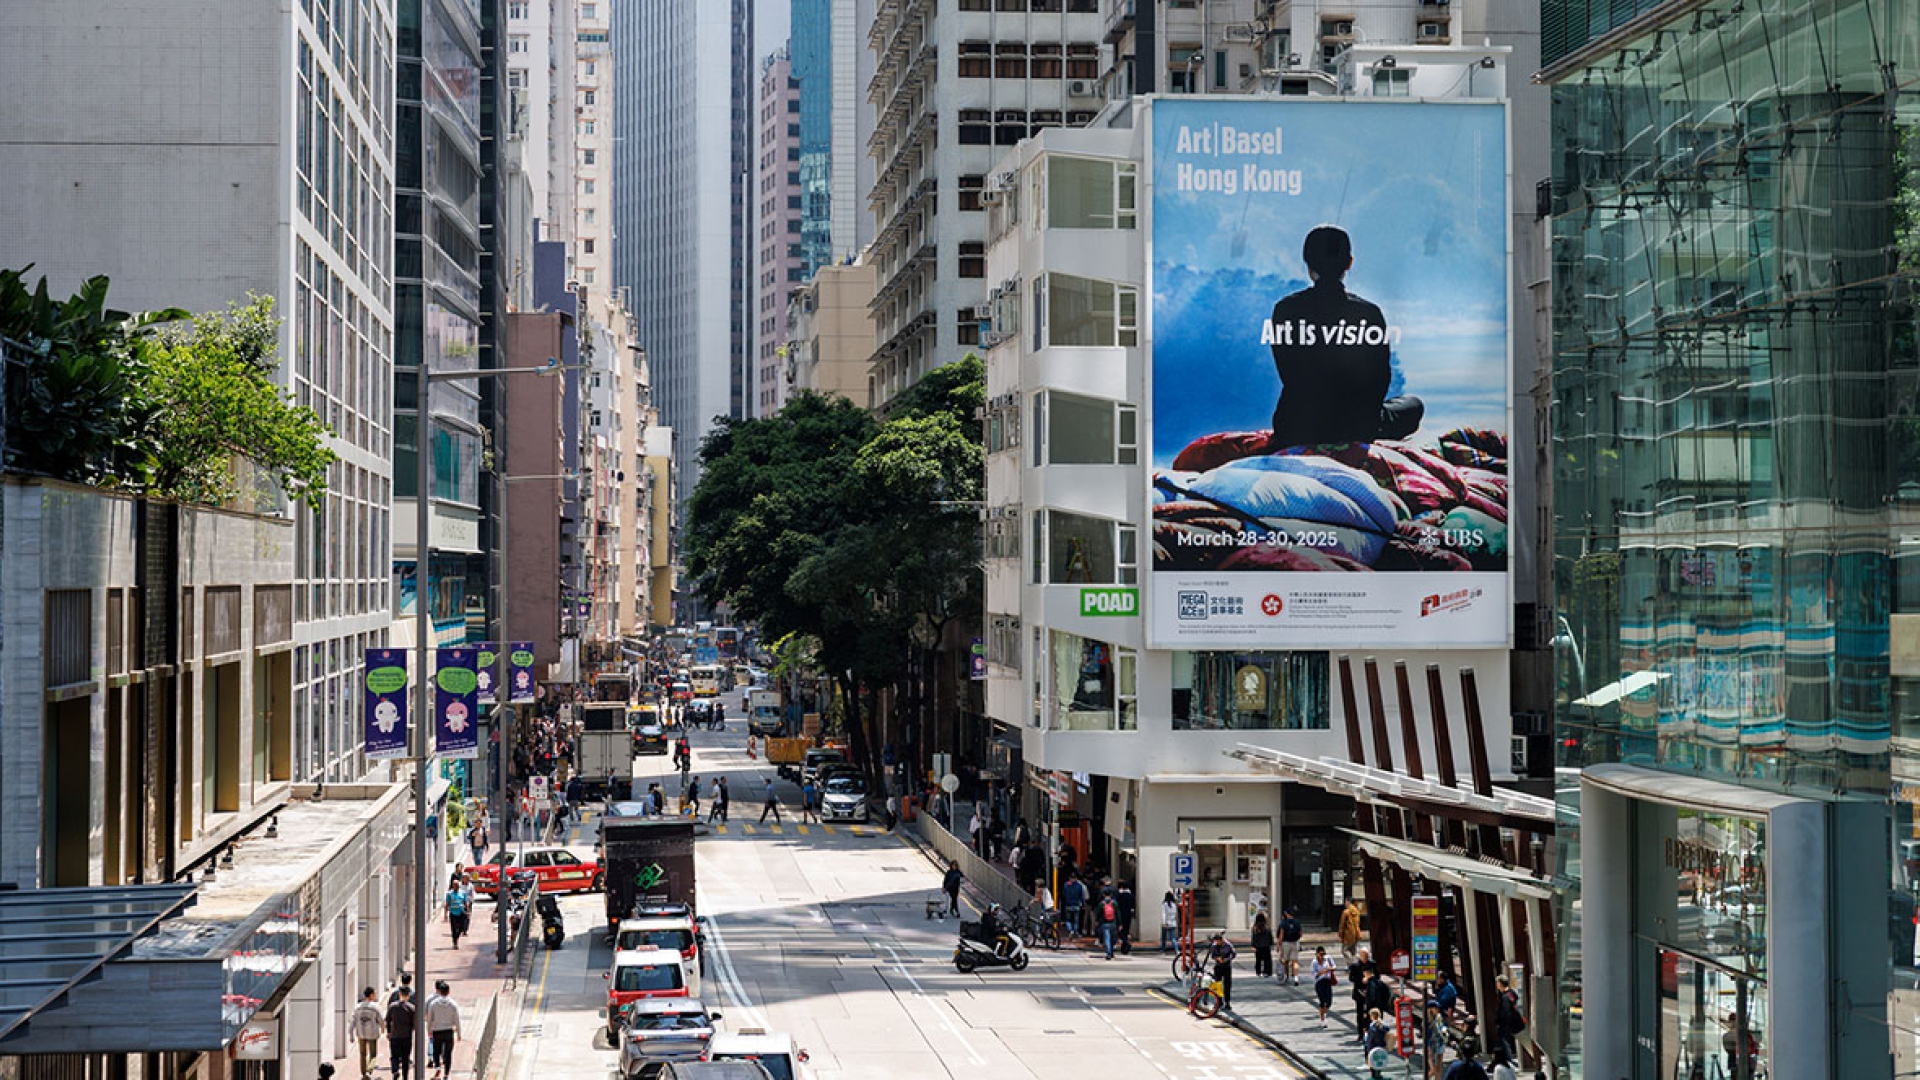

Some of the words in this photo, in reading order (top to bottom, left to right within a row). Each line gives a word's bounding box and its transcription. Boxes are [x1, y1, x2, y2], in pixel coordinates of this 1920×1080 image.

[1177, 163, 1237, 196] Hong
[1243, 163, 1302, 196] Kong
[1260, 319, 1293, 345] Art
[1299, 319, 1317, 346] is
[1321, 319, 1402, 346] vision
[1176, 531, 1233, 547] March
[1297, 531, 1338, 547] 2025
[1443, 529, 1484, 547] UBS
[1084, 592, 1135, 612] POAD
[1177, 858, 1190, 873] P
